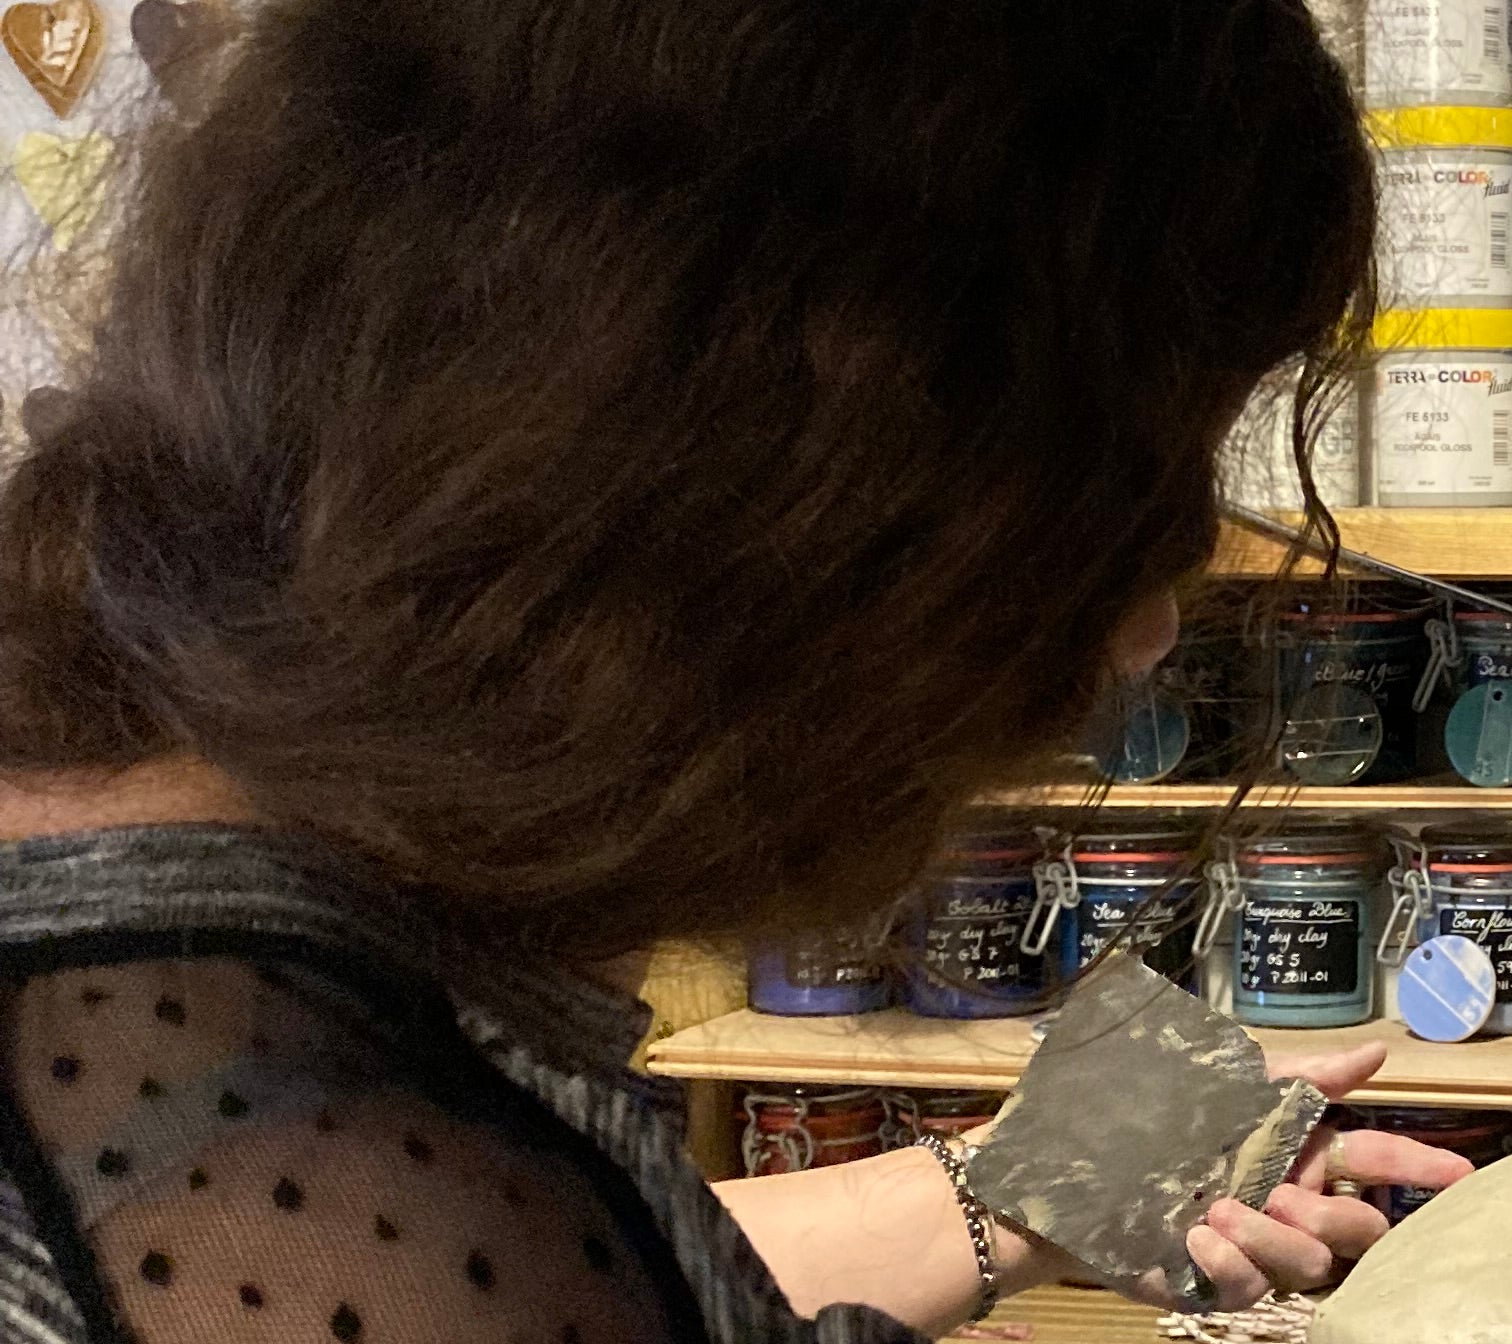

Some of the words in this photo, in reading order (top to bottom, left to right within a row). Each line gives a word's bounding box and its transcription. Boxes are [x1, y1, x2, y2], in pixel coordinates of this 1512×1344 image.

[1437, 370, 1494, 384] COLOR
[1405, 412, 1420, 423] FE
[1268, 927, 1291, 954] dry
[1297, 926, 1329, 949] clay
